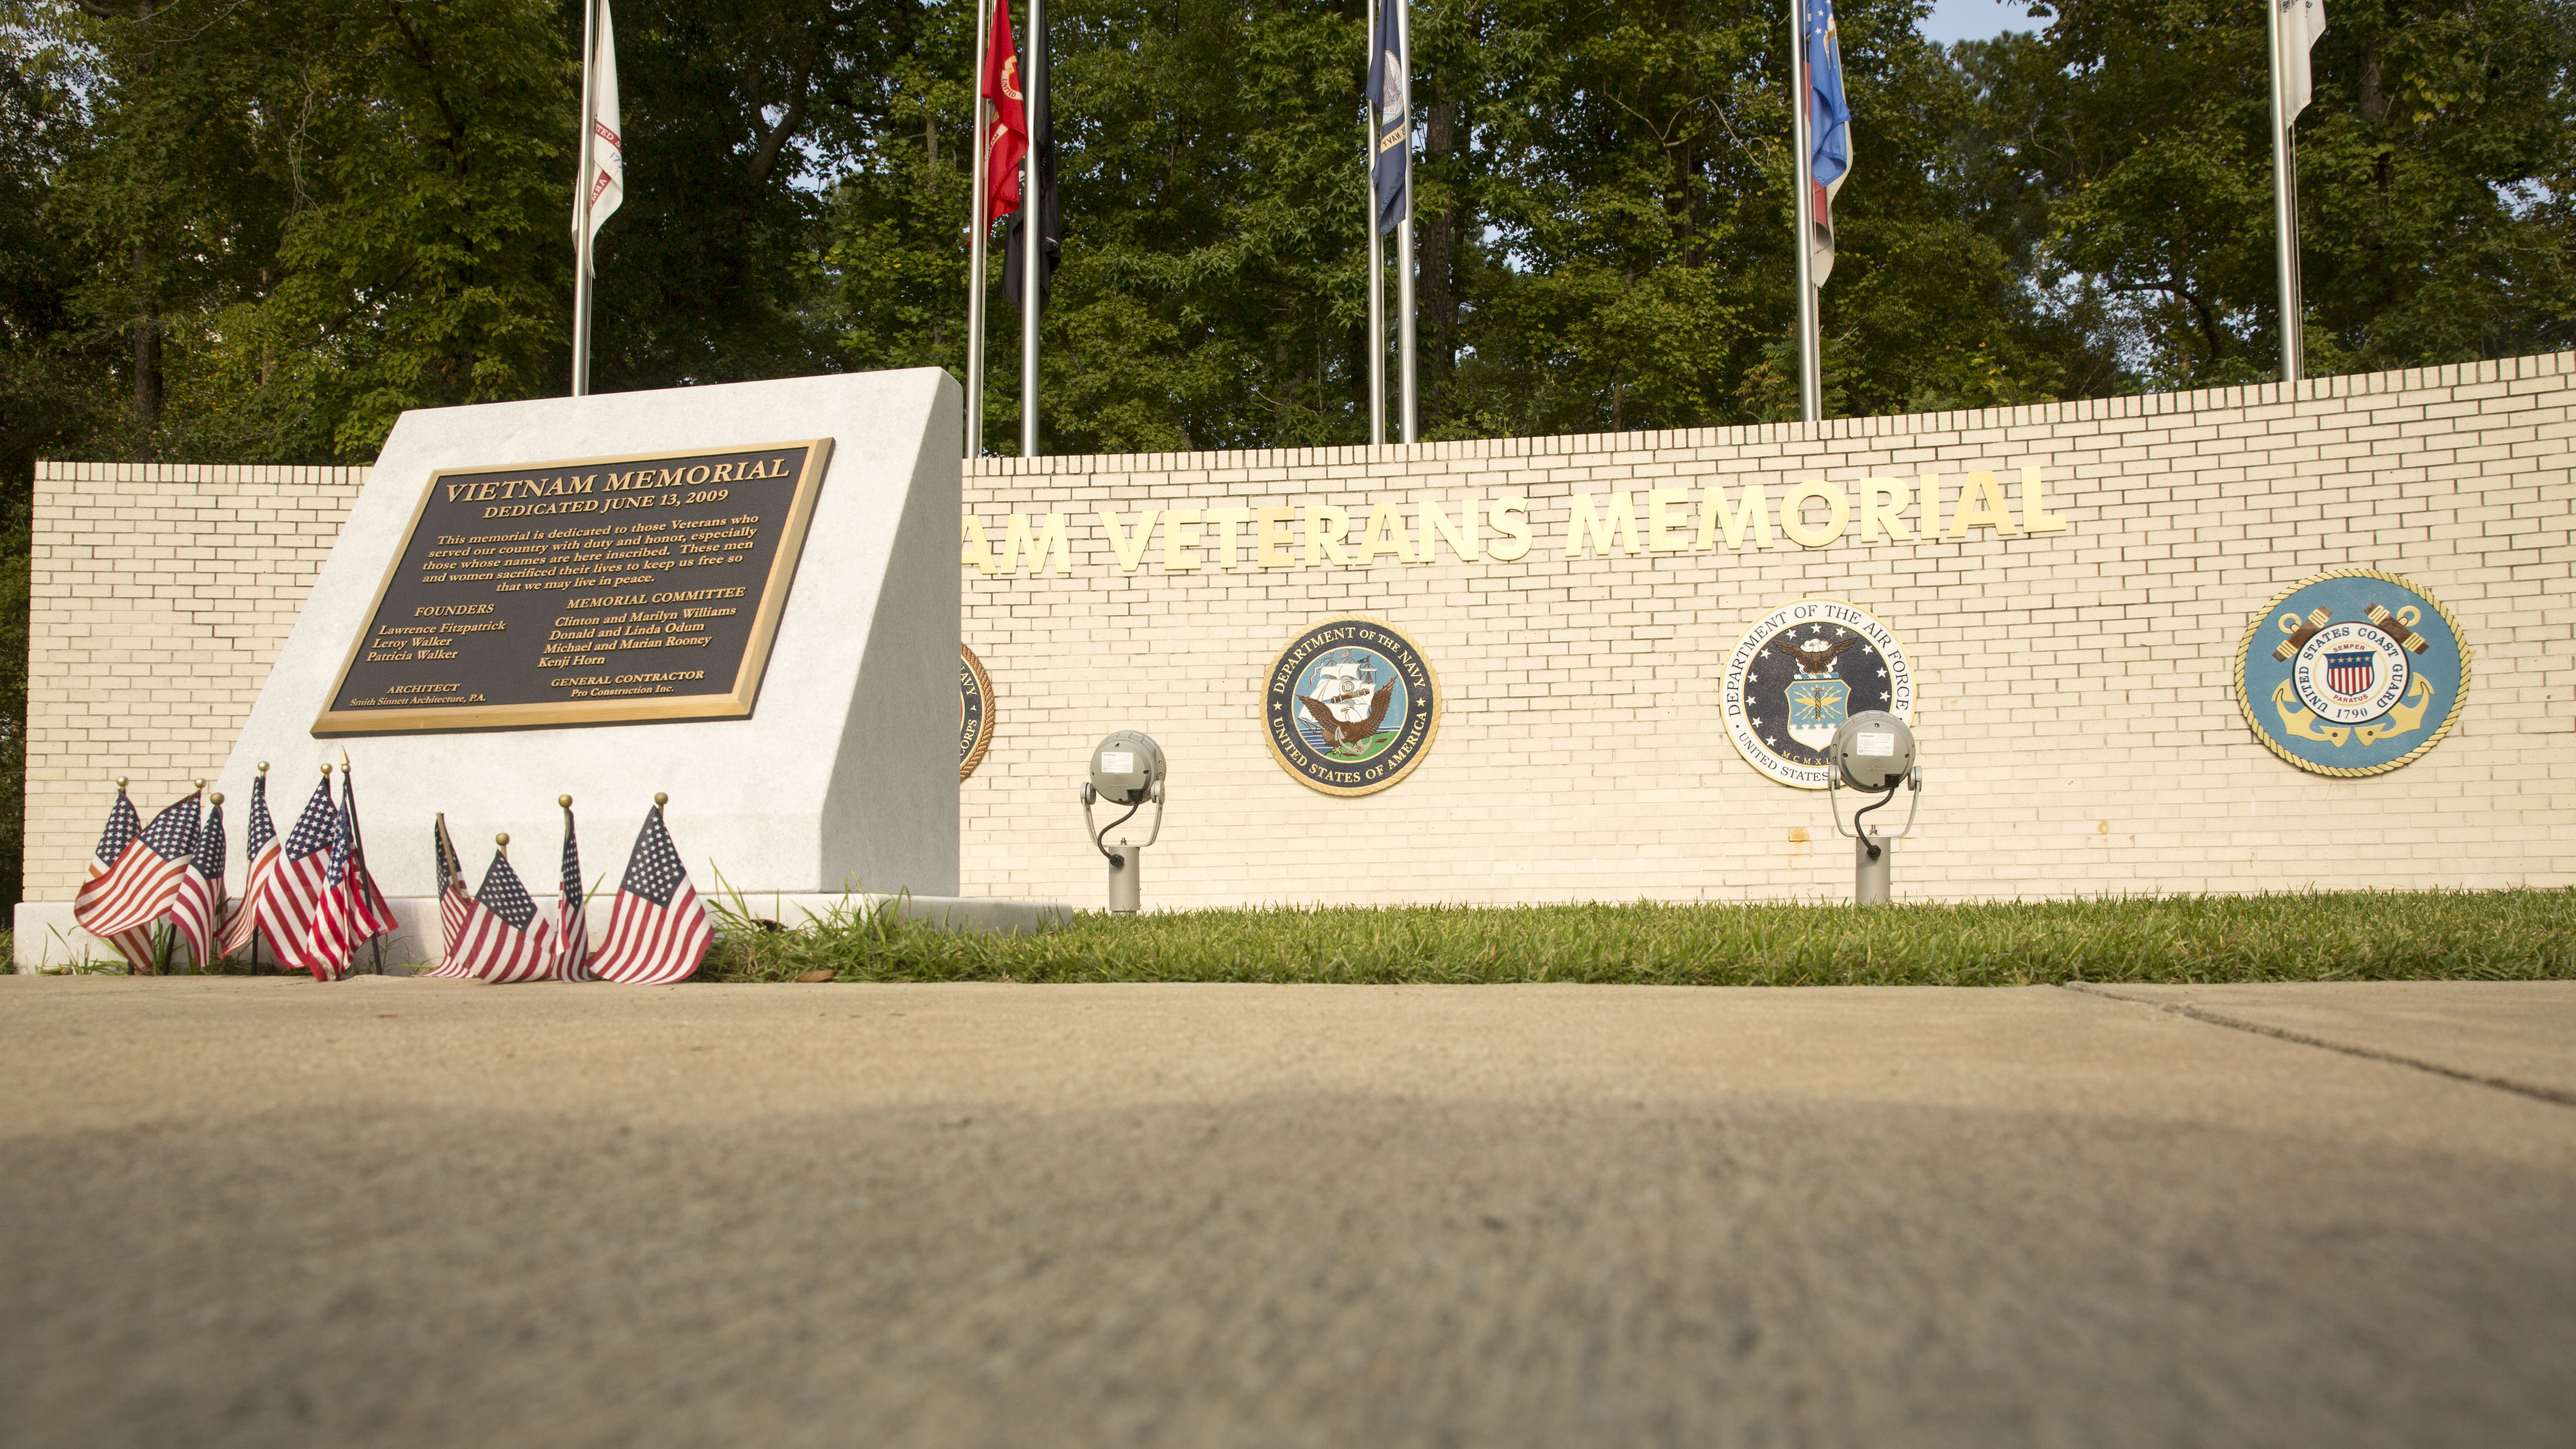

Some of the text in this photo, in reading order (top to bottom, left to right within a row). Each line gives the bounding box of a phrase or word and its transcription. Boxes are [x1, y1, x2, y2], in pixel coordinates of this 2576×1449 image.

[1002, 78, 1016, 98] UNITED
[447, 459, 790, 502] VIETNAM MEMORIAL
[482, 489, 729, 518] DEDICATED JUNE 13, 2009
[1098, 496, 1533, 572] VETERANS
[1565, 466, 2067, 557] MEMORIAL
[438, 514, 759, 545] This memorial is dedicated to those Veterans who
[428, 547, 471, 558] served
[499, 544, 549, 555] country
[553, 541, 580, 551] with
[584, 538, 613, 550] duty
[616, 536, 641, 547] and
[644, 533, 687, 544] honor,
[691, 527, 758, 543] especially
[423, 542, 754, 571] those whose names are here inscribed. These men
[422, 555, 743, 583] and women sacrificed their lives to keep us free so
[497, 575, 655, 592] that we may live in peace.
[566, 587, 746, 609] MEMORIAL COMMITTEE
[414, 604, 495, 617] FOUNDERS
[555, 607, 737, 627] Clinton and Marilyn Williams
[378, 621, 507, 636] Lawrence Fitzpatrick
[549, 622, 705, 641] Donald and Linda Odum
[371, 637, 453, 650] Leroy Walker
[543, 635, 713, 654] Michael and Marian Rooney
[2333, 644, 2366, 653] SEMPER
[366, 650, 459, 662] Patricia Walker
[537, 655, 606, 670] Kenji Horn
[1273, 627, 1426, 695] DEPARTMENT OF THE NAVY
[1726, 605, 1910, 717] DEPARTMENT OF THE AIR FORCE
[551, 670, 705, 688] GENERAL CONTRACTOR
[2299, 627, 2403, 713] UNITED STATES COAST GUARD
[386, 683, 461, 695] ARCHITECT
[570, 684, 675, 698] Pro Construction Inc.
[2333, 693, 2368, 703] PARATUS
[349, 694, 486, 707] Smith Sinnett Architecture, P.A.
[2336, 707, 2367, 719] 1790
[1273, 711, 1427, 783] UNITED STATES OF AMERICA
[1739, 731, 1828, 781] UNITED STATES
